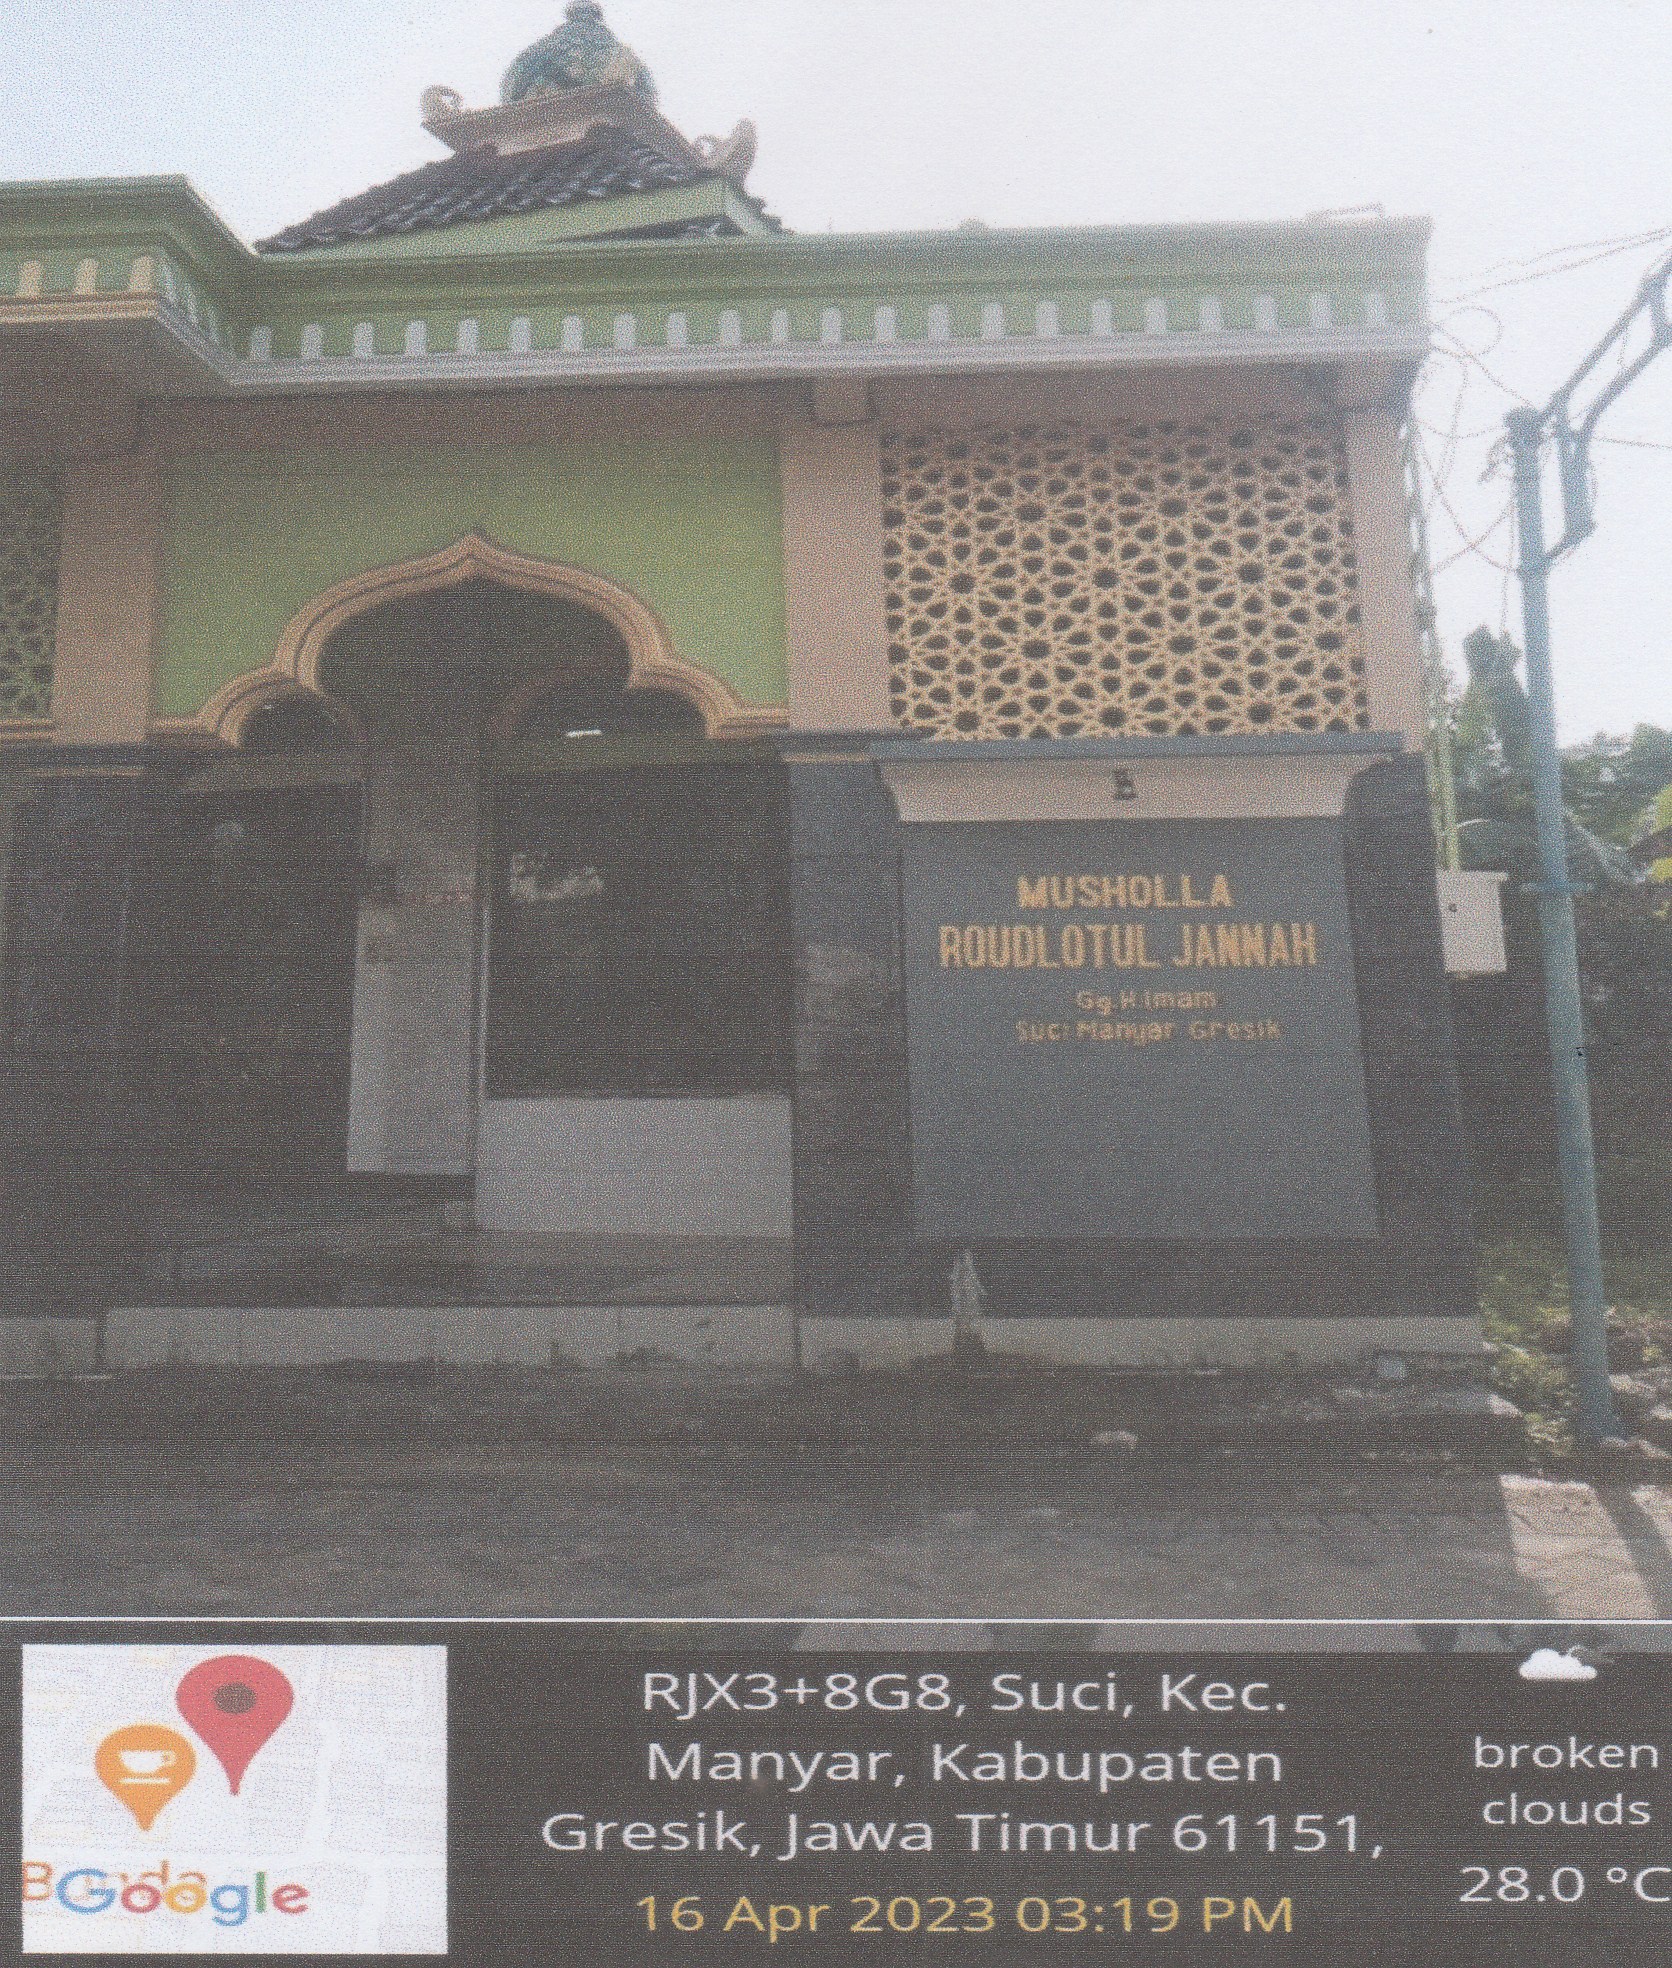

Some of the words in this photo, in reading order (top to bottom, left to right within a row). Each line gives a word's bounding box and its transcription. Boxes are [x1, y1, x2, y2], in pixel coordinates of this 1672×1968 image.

[1017, 874, 1233, 909] MUSHOLLA
[939, 922, 1160, 969] ROUDLOTUL
[1174, 920, 1317, 968] JANNAH
